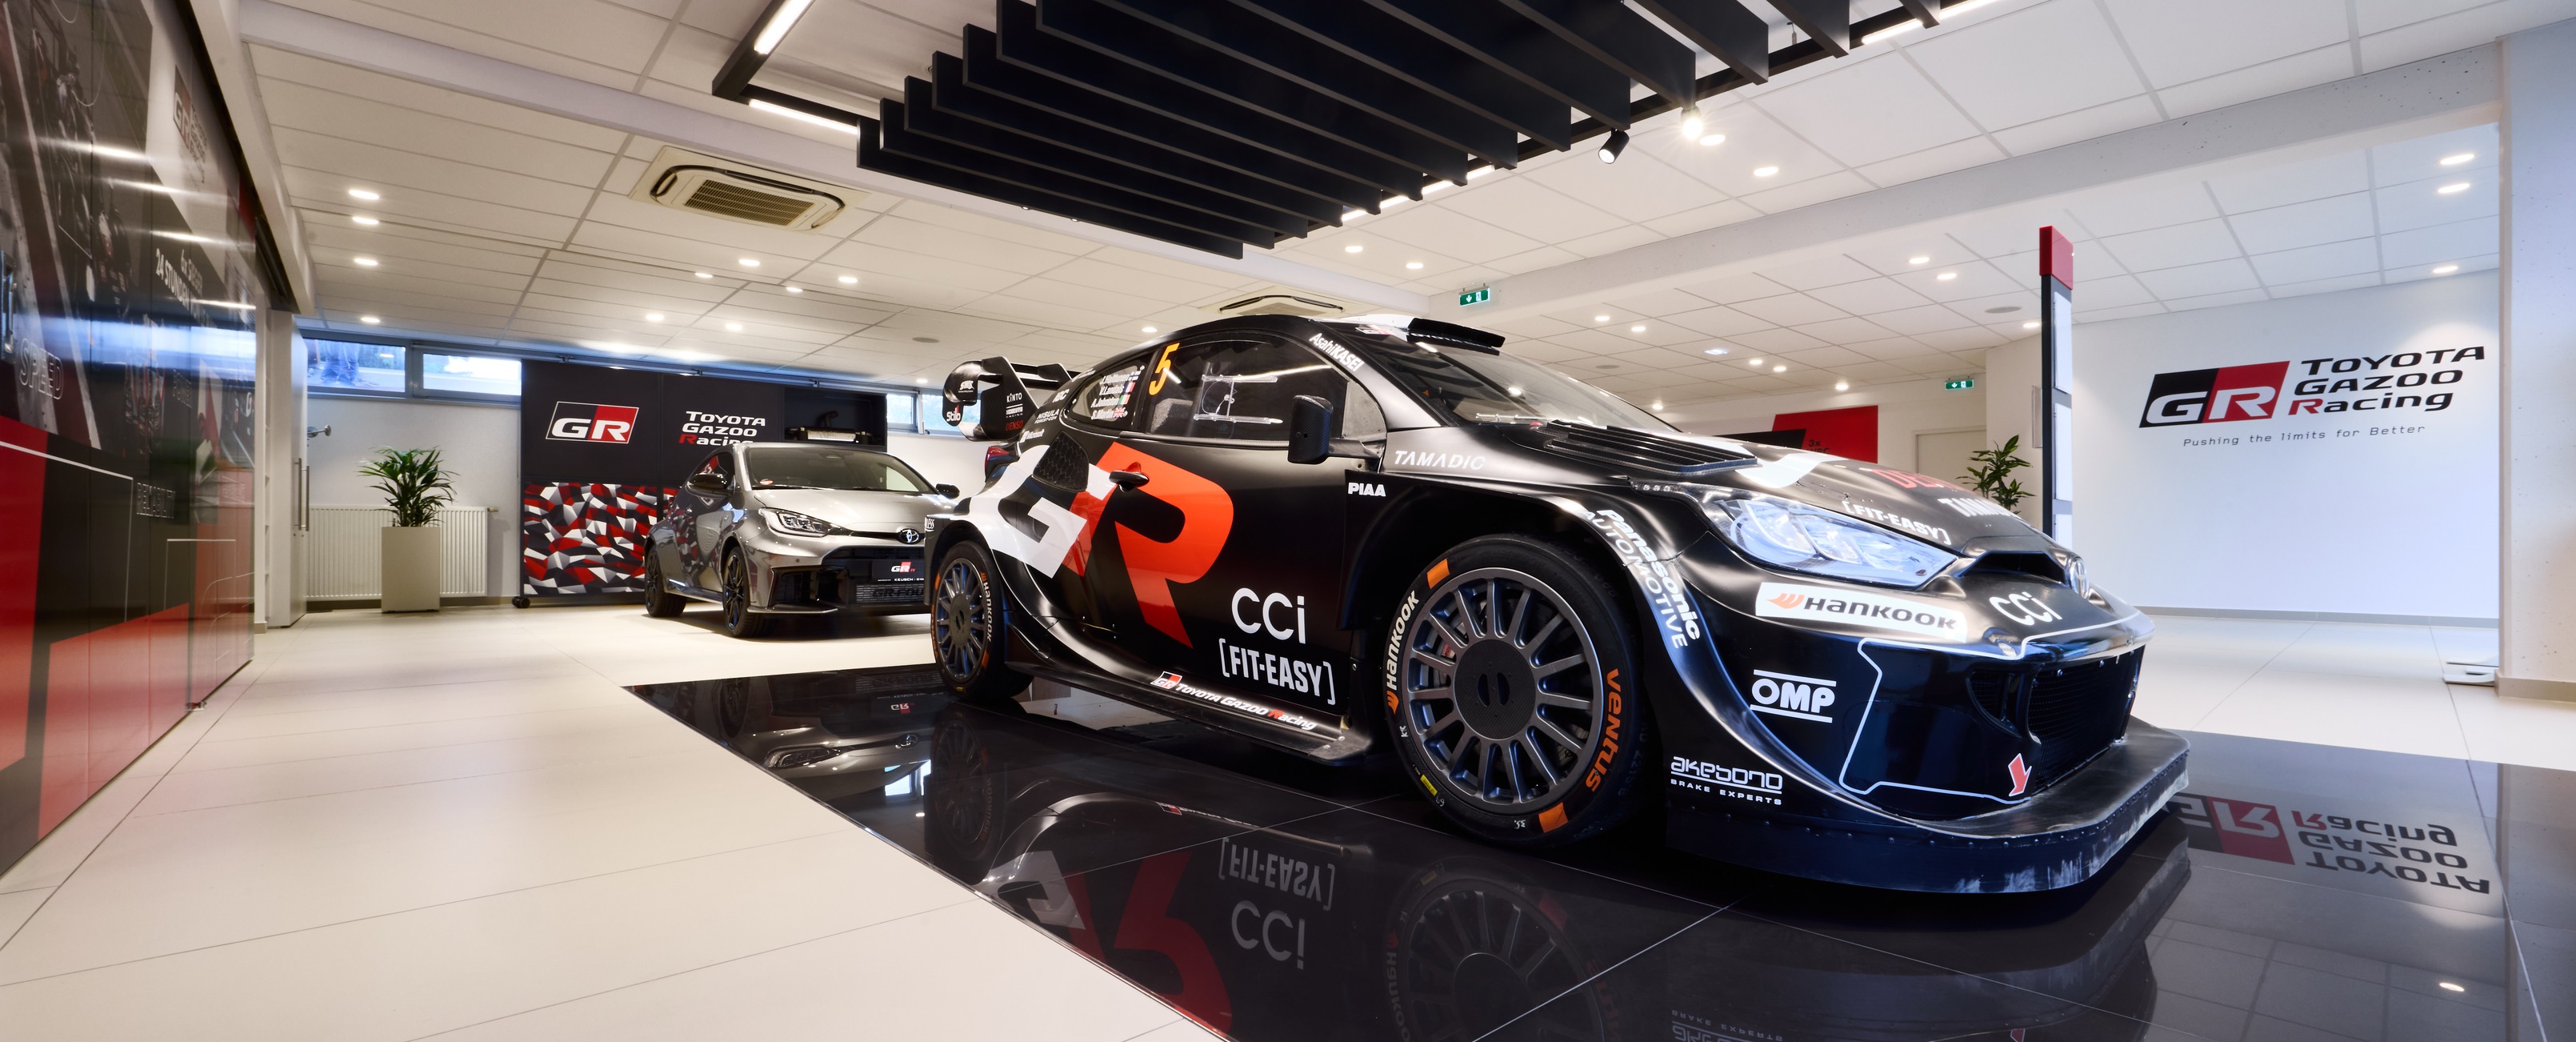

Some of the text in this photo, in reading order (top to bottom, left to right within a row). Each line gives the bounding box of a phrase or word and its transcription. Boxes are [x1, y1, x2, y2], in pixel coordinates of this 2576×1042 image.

[156, 248, 164, 280] 24
[1309, 333, 1364, 371] AsahiKASEI
[2301, 347, 2485, 375] TOYOTA
[19, 338, 63, 399] SPEED
[1149, 343, 1180, 395] 5
[2294, 370, 2463, 396] GAZOO
[946, 404, 961, 422] Stilo
[2146, 386, 2276, 423] GR
[2288, 392, 2454, 416] Racing
[551, 418, 630, 442] GR
[682, 423, 758, 437] GAZOO
[686, 411, 766, 427] TOYOTA
[1006, 421, 1024, 431] DENSO
[2183, 424, 2425, 447] Pushing the limits for Better
[1394, 450, 1486, 471] TAMADIC
[1347, 482, 1386, 497] PIAA
[964, 441, 1234, 649] GR
[891, 564, 910, 572] GR
[1581, 511, 1688, 649] AUTOMOTIVE
[1596, 509, 1701, 640] Panasonic
[1175, 683, 1222, 703] TOYOTA
[1220, 696, 1268, 715] GAZOO
[1267, 709, 1318, 731] Racing
[1751, 678, 1835, 713] OMP
[1670, 755, 1783, 791] akebono
[1670, 778, 1782, 806] BRAKE EXPERTS
